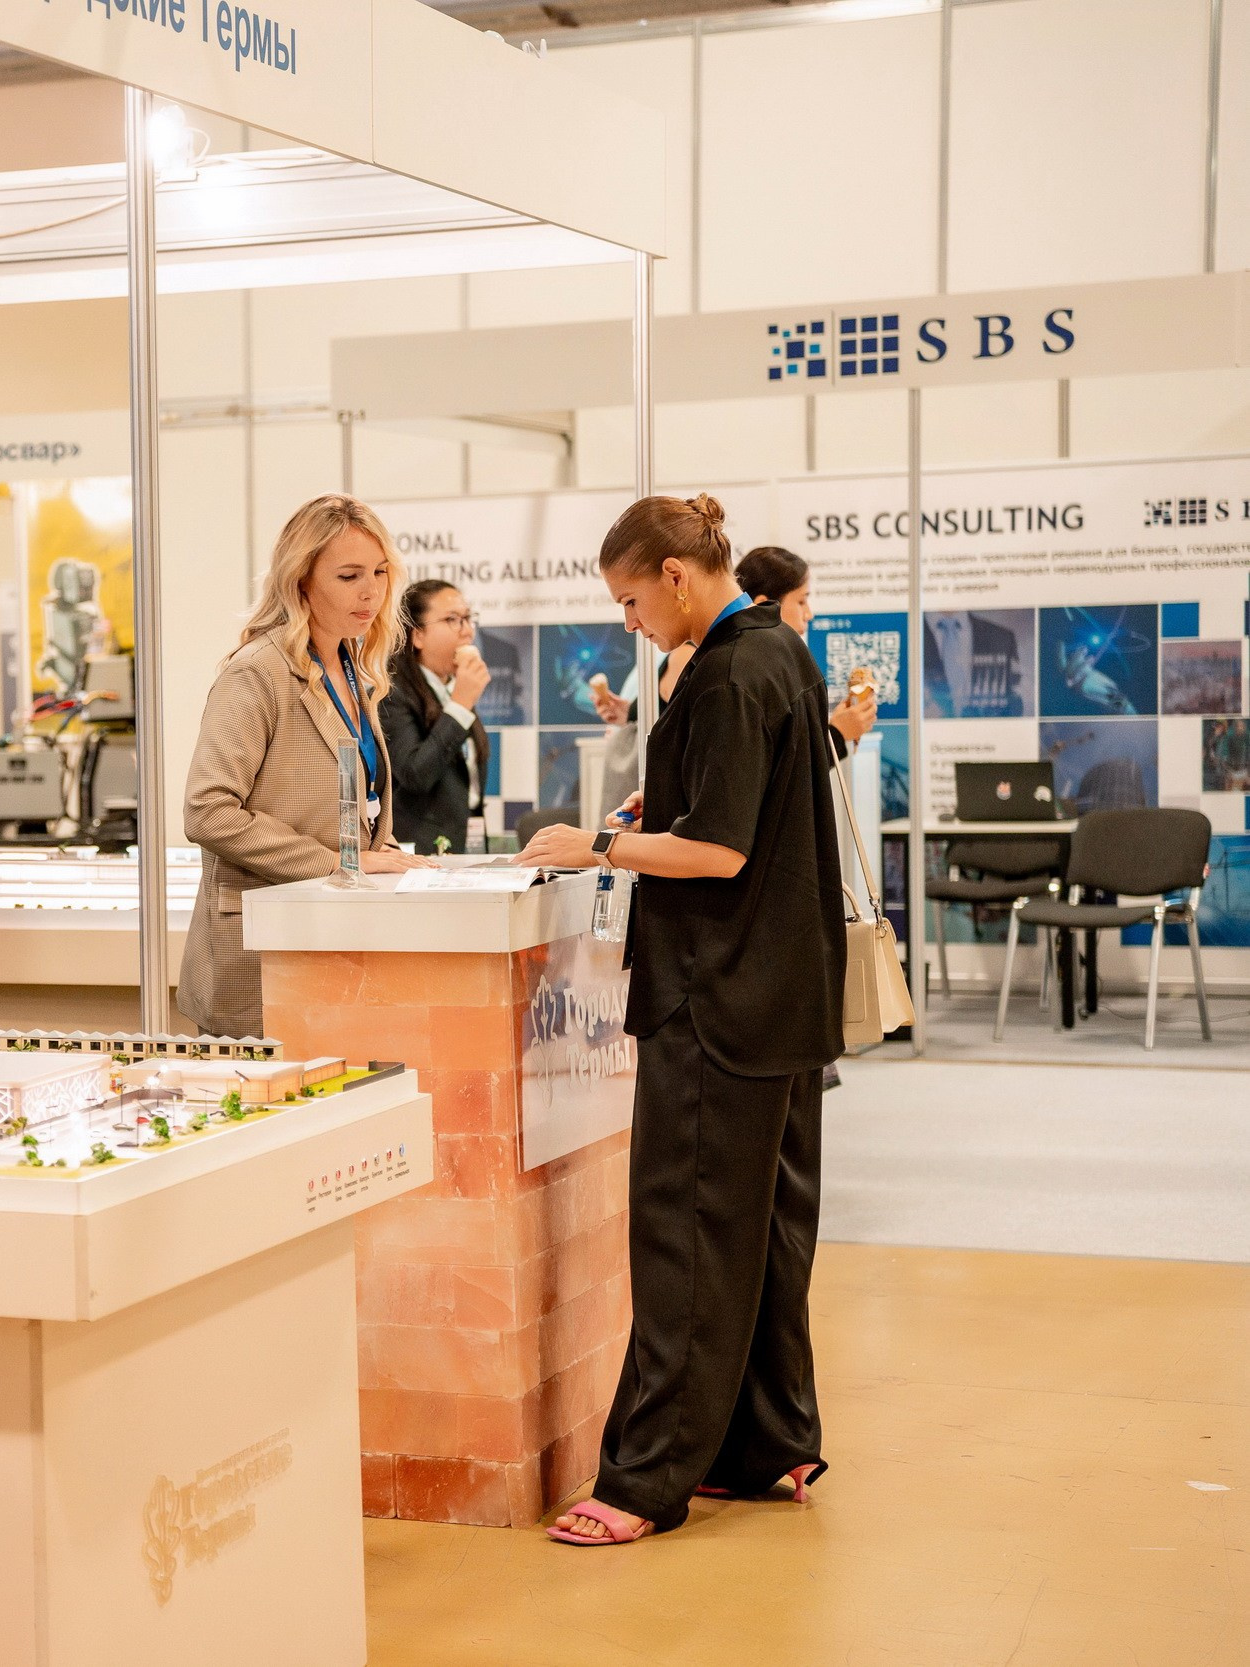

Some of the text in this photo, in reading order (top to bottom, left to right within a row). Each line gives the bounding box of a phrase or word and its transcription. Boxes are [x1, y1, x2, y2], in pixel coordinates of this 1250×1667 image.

[806, 503, 1085, 541] SBS CONSULTING
[394, 530, 461, 555] ONAL
[406, 556, 601, 583] ULTING ALLIANC
[565, 1037, 631, 1095] Термы
